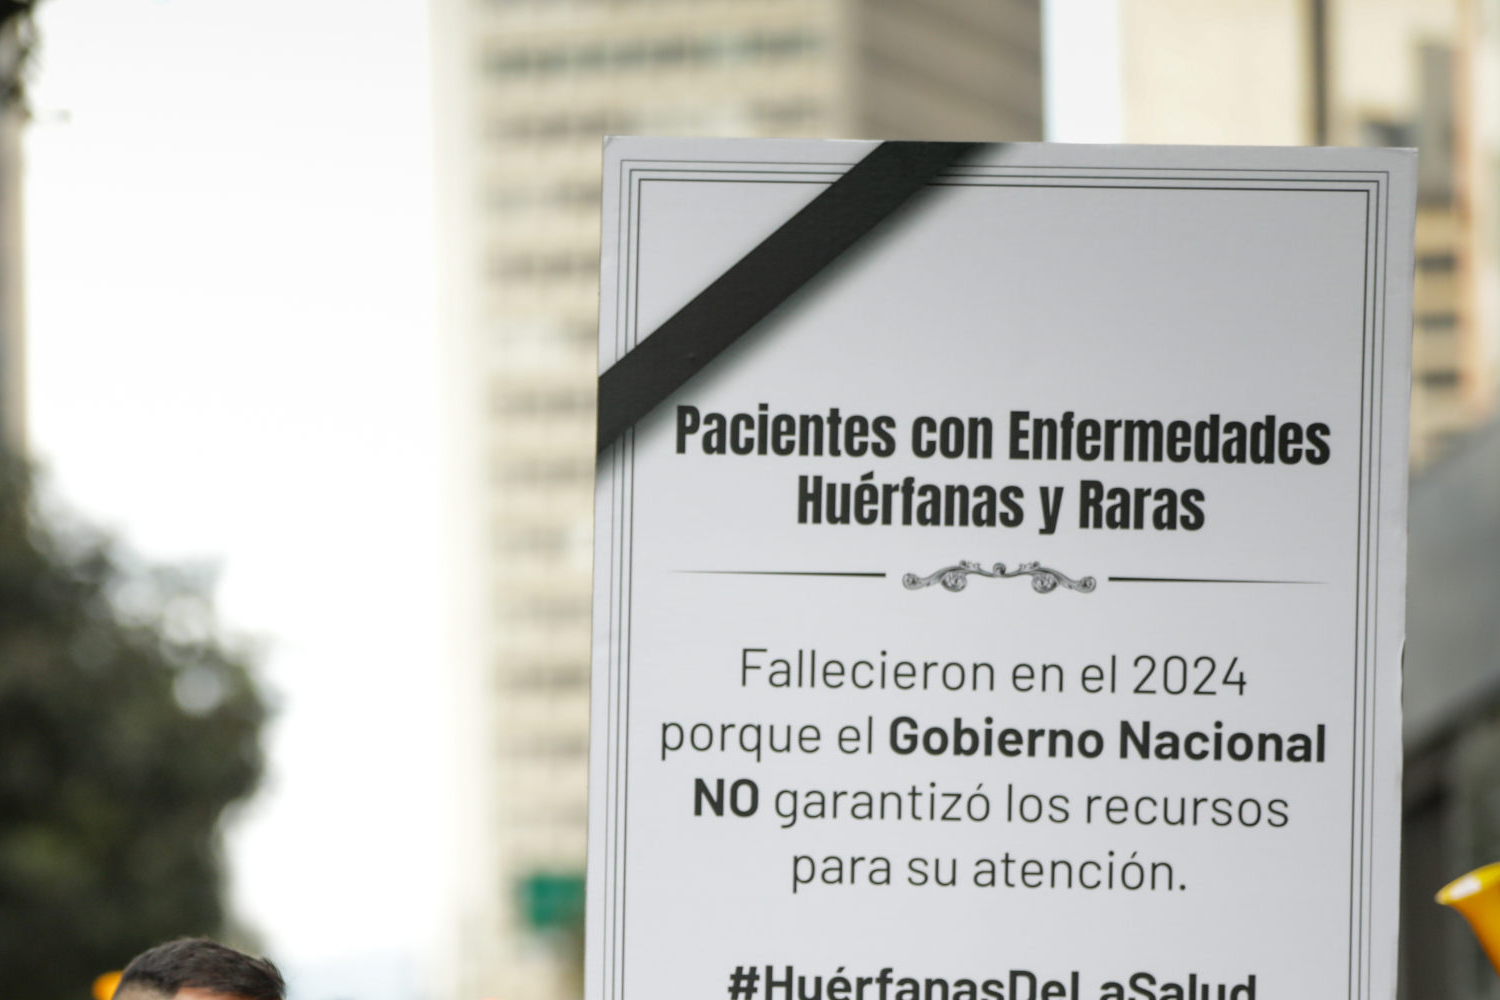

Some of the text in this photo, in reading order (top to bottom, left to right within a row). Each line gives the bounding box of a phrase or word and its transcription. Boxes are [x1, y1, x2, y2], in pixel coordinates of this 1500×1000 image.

[675, 404, 1330, 465] Pacientes con Enfermedades
[798, 471, 1205, 535] Huérfanas y Raras
[742, 648, 1246, 695] Fallecieron en el 2024
[662, 716, 1325, 762] porque el Gobierno Nacional
[694, 778, 1288, 828] NO garantizó los recursos
[793, 851, 1186, 893] para su atención.
